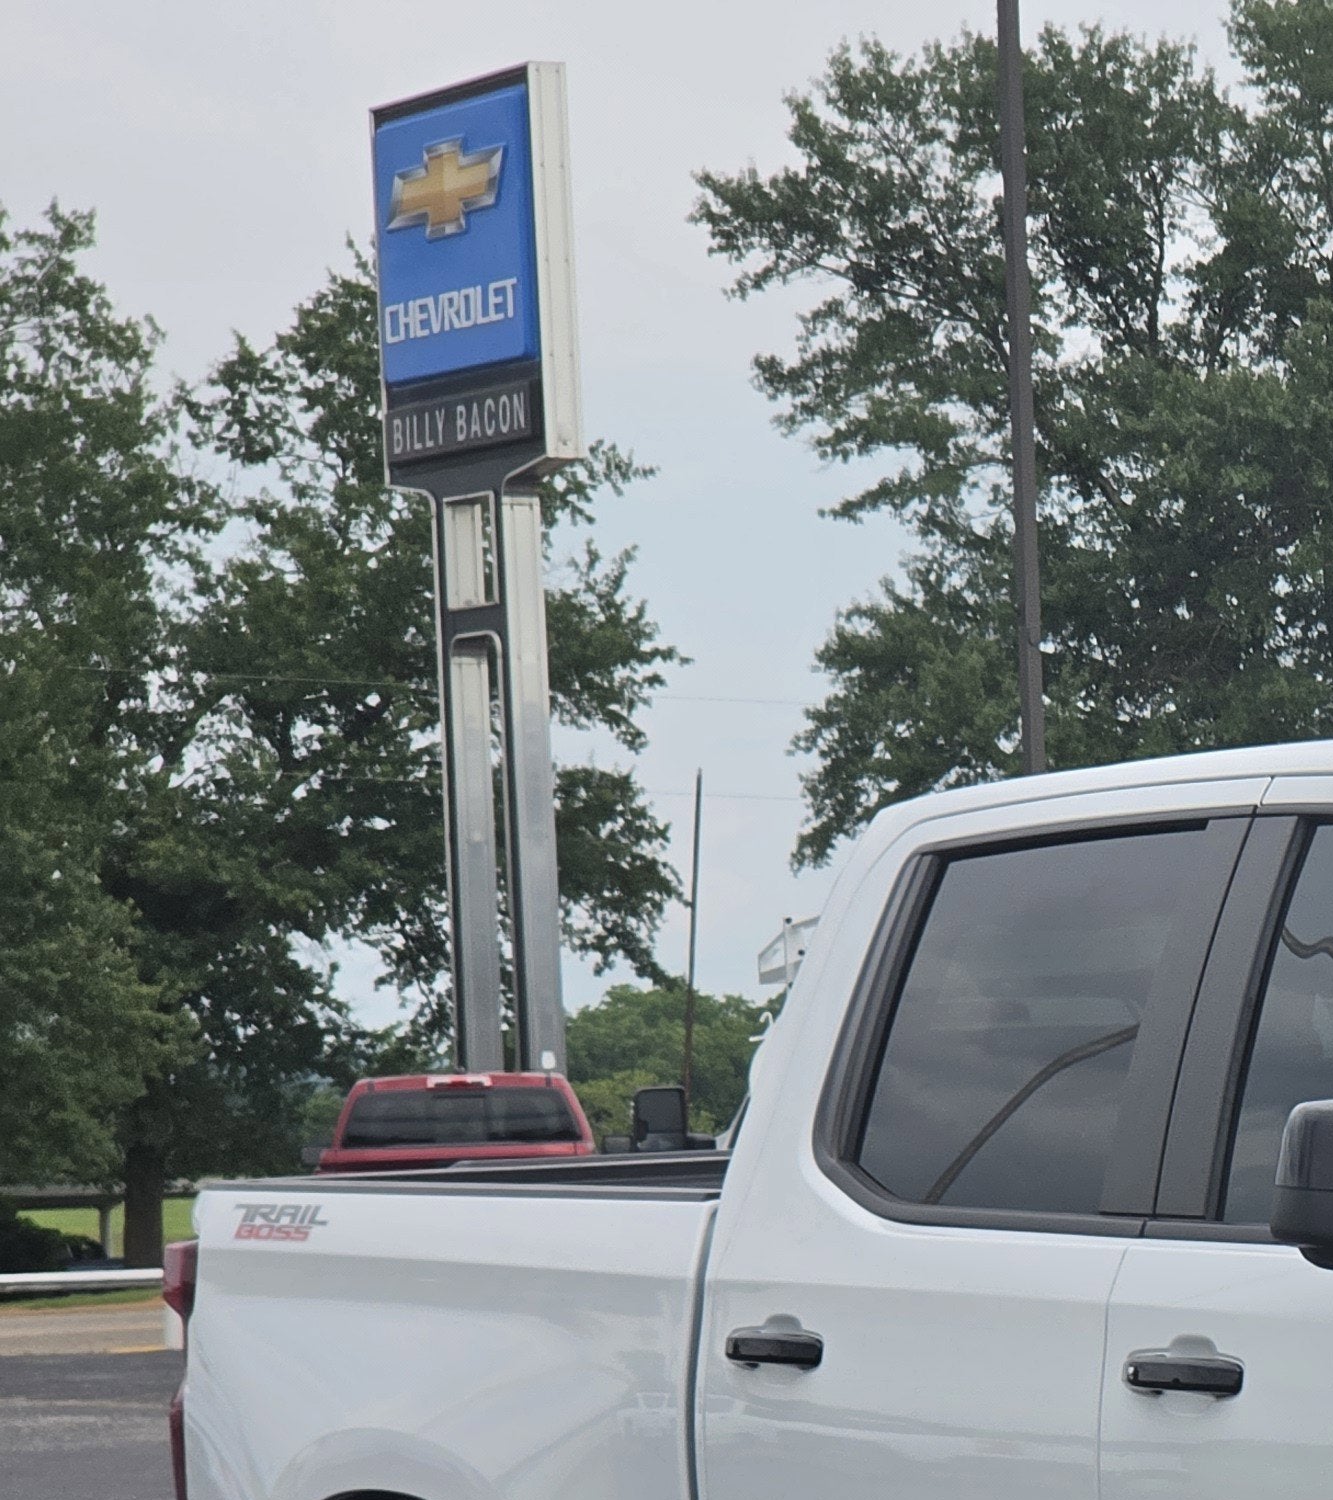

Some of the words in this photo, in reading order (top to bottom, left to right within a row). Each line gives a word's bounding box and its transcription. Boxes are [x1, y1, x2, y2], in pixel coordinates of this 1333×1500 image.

[385, 278, 517, 344] CHEVROLET
[393, 407, 445, 455] BILLY
[456, 391, 527, 443] BACON
[234, 1203, 328, 1226] TRAIL
[234, 1224, 312, 1241] BOSS
